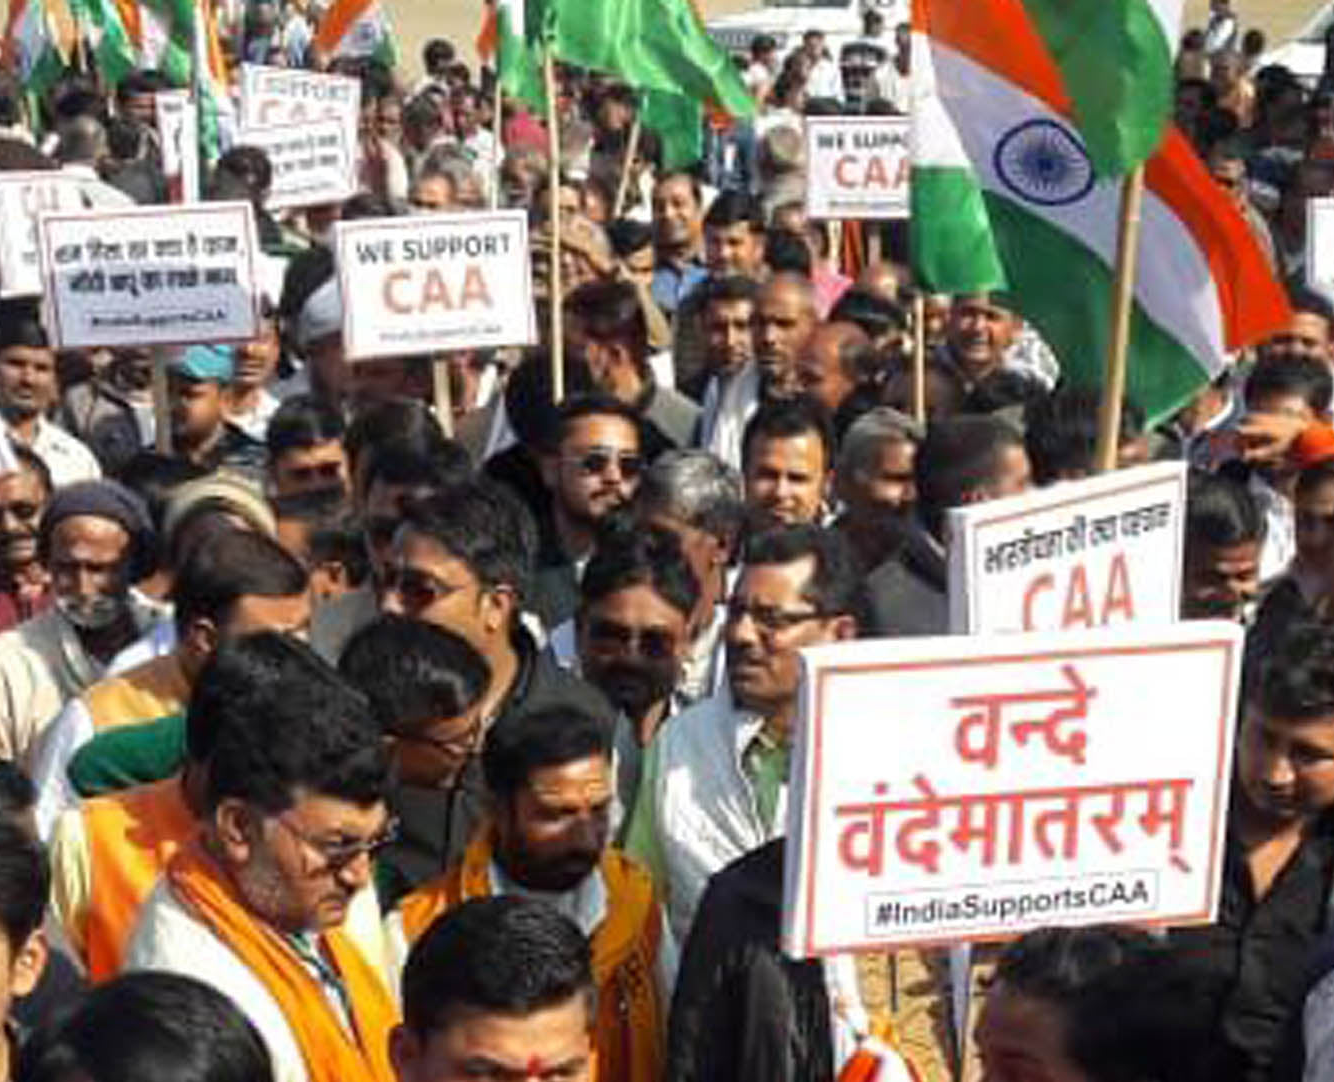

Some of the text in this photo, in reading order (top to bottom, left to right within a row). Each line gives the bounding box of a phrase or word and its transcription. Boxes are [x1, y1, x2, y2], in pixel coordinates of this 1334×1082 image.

[356, 233, 510, 264] WE SUPPORT
[383, 264, 494, 314] CAA
[1021, 550, 1135, 632] CAA
[950, 664, 1098, 769] वन्दे
[834, 774, 1194, 877] वंदेमातरम्
[875, 879, 1150, 927] #IndiaSupportsCAA
